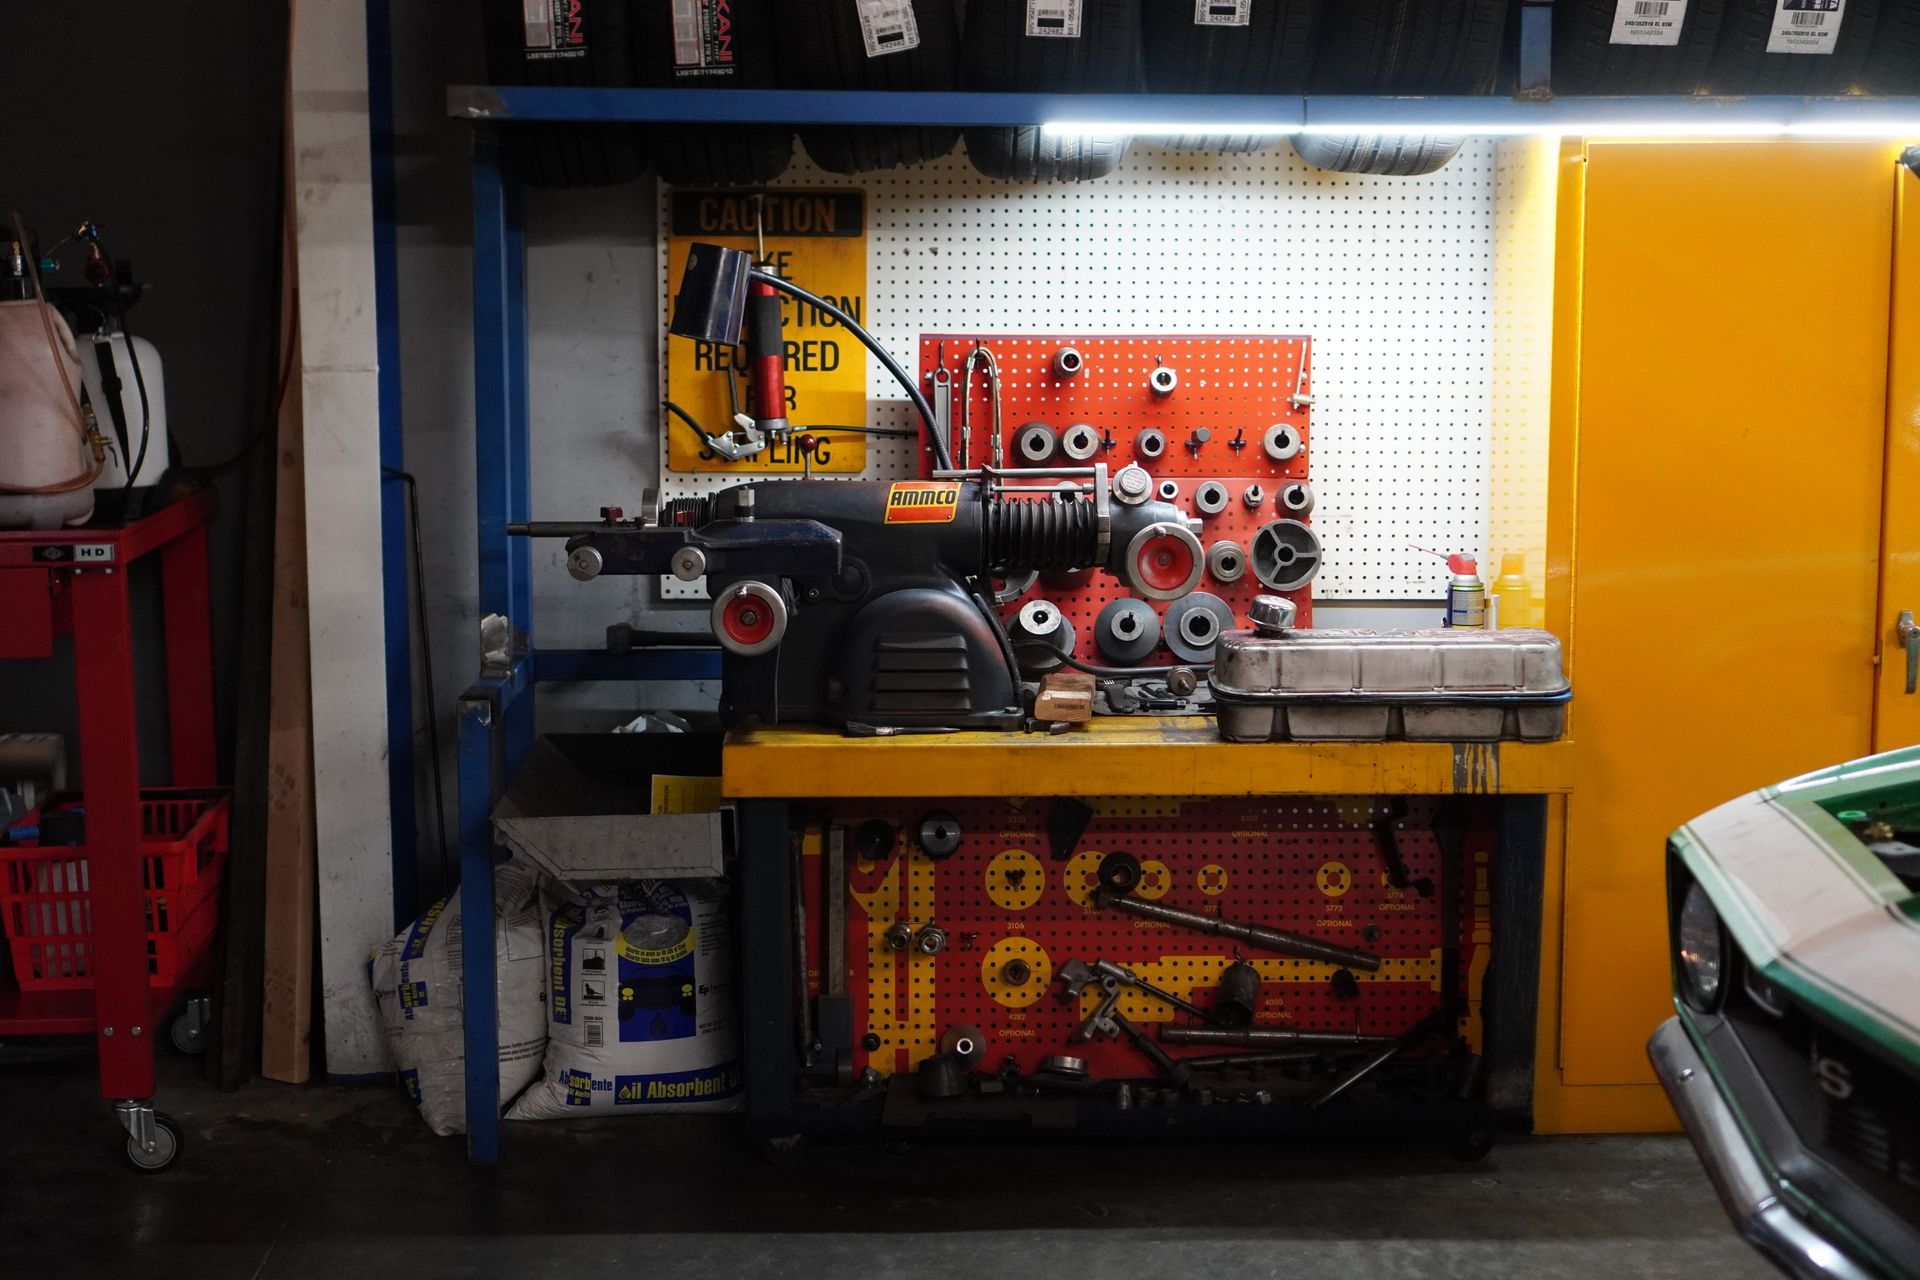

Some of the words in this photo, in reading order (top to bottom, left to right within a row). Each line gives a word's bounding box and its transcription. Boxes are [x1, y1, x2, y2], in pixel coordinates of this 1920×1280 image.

[1038, 27, 1064, 35] 242482
[699, 196, 837, 233] CAUTION
[695, 340, 840, 378] REQRED
[890, 490, 957, 506] AMMCO
[999, 830, 1036, 838] OPTIONAL
[1231, 830, 1269, 838] OPTIONAL
[1378, 903, 1416, 911] OPTIONAL
[1007, 922, 1025, 930] 3106
[1133, 920, 1171, 929] OPTIONAL
[1316, 919, 1353, 927] OPTIONAL
[1255, 1011, 1293, 1019] OPTIONAL
[998, 1029, 1036, 1037] OPTIONAL
[559, 1069, 613, 1091] Absorbente
[646, 1071, 726, 1099] Absorbent
